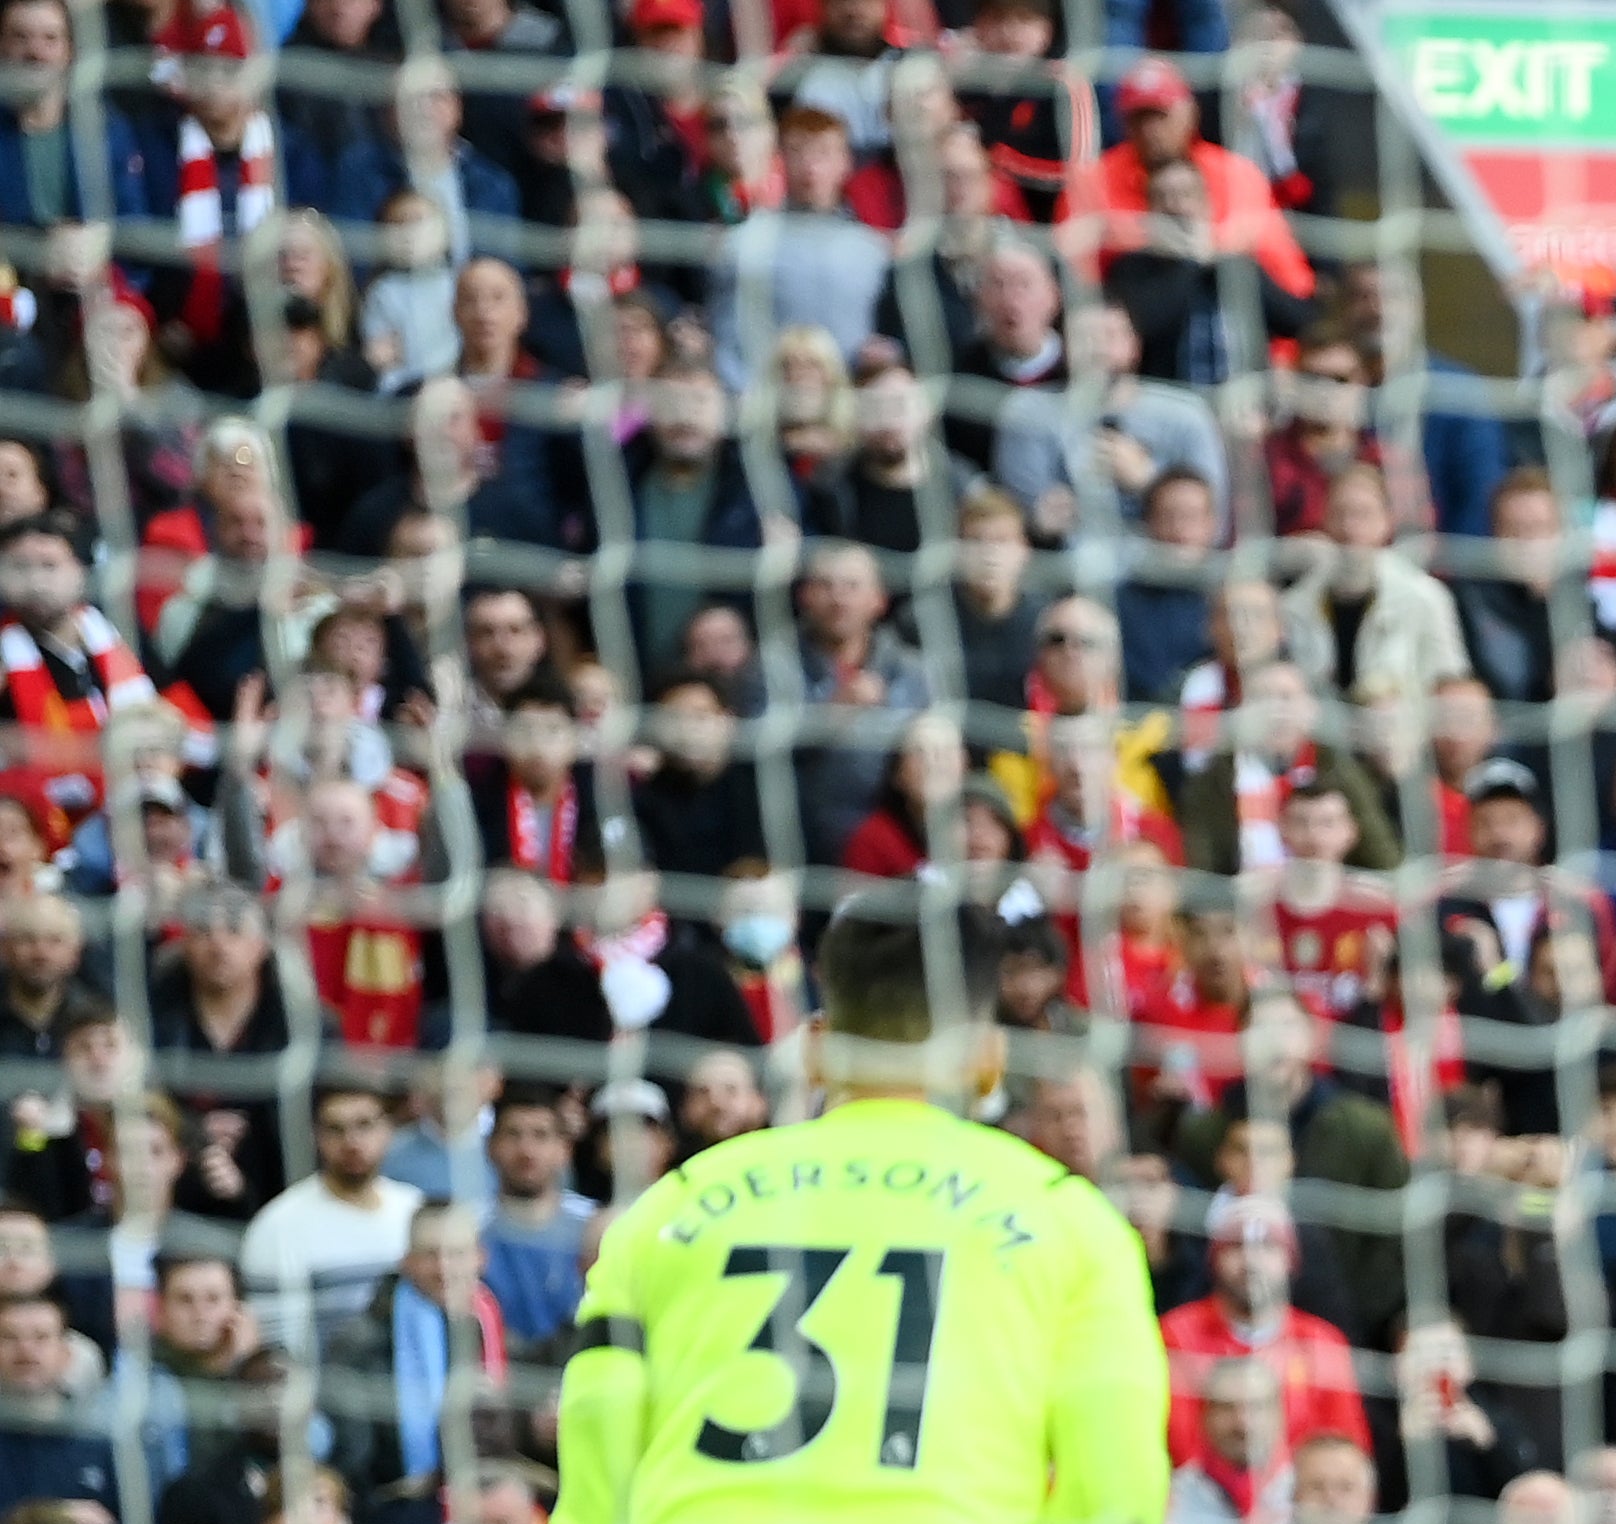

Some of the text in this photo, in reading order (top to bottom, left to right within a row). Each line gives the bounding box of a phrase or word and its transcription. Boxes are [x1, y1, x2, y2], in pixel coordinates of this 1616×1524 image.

[1413, 36, 1608, 119] EXIT
[667, 1160, 981, 1246] EDERSON
[692, 1243, 951, 1470] 31
